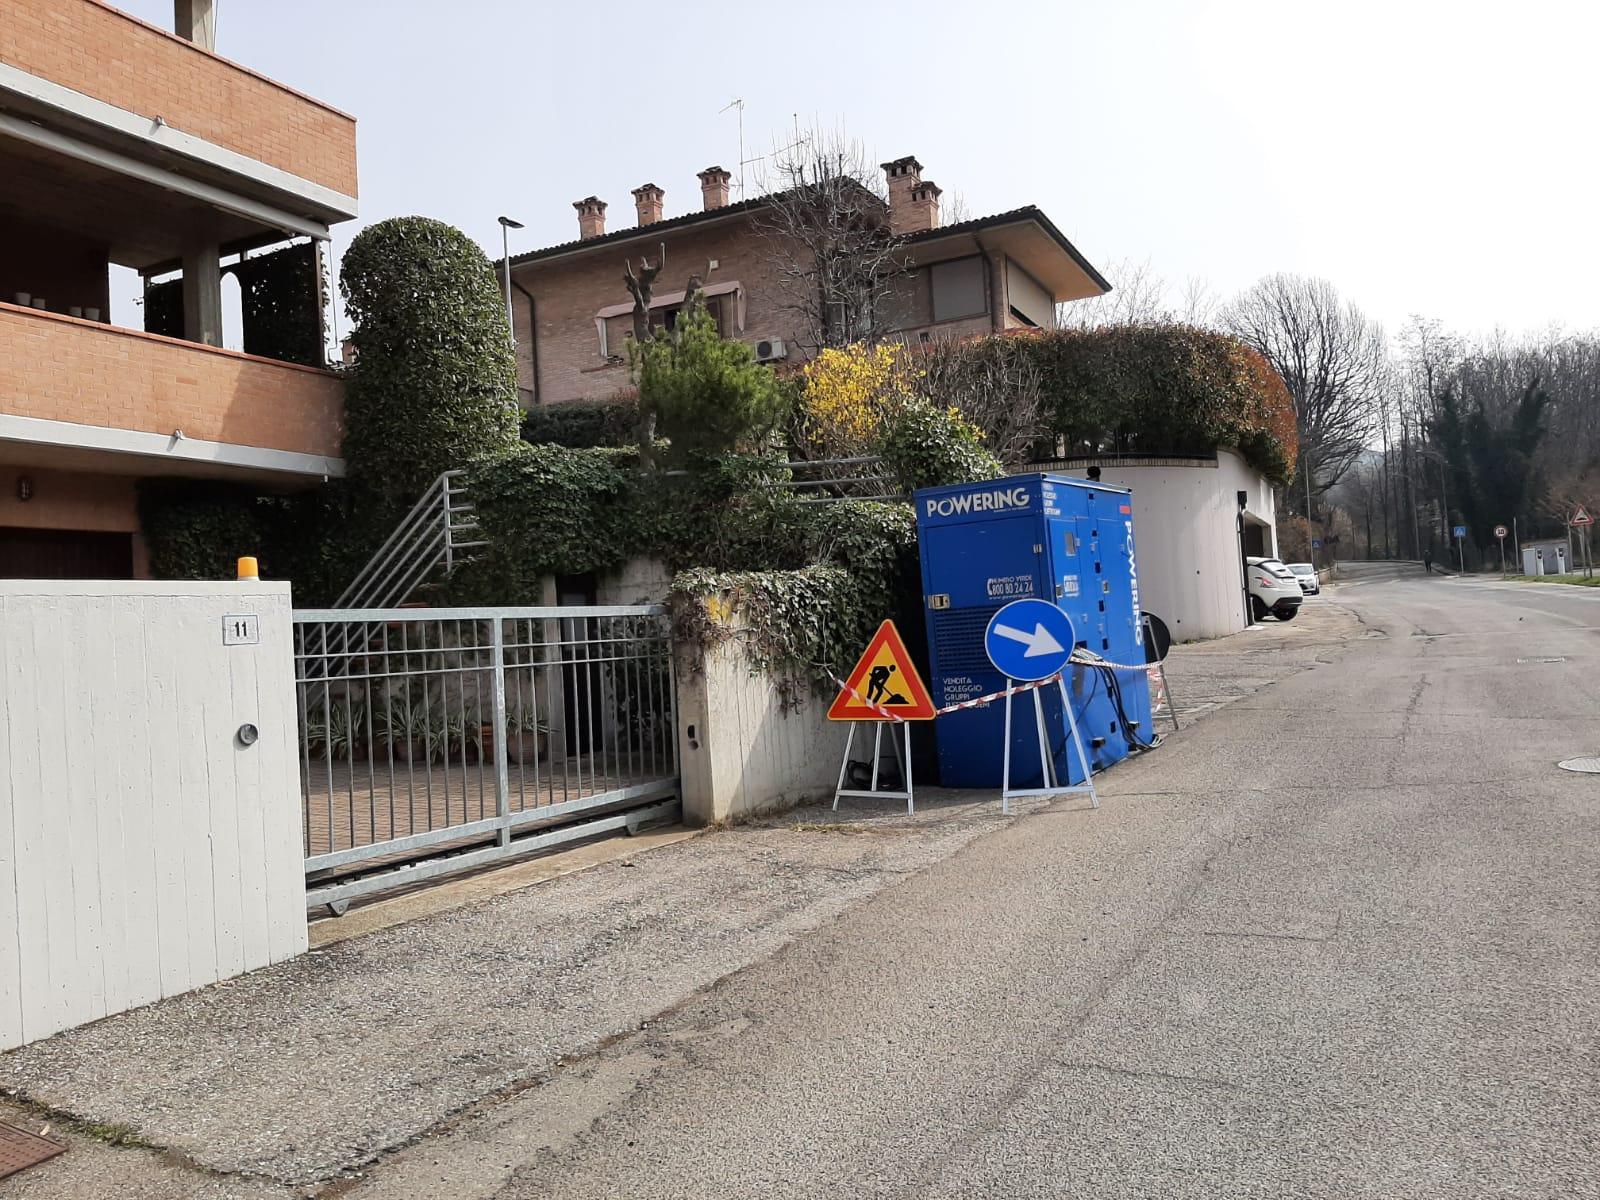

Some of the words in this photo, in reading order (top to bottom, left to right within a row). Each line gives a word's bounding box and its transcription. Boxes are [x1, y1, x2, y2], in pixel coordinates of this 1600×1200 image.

[926, 488, 1030, 518] POWERING
[992, 584, 1004, 596] 800
[1014, 582, 1024, 594] 24
[1024, 581, 1033, 593] 24
[1124, 521, 1142, 646] POWERING
[234, 621, 247, 637] 11
[943, 685, 983, 693] NOLEGGIO
